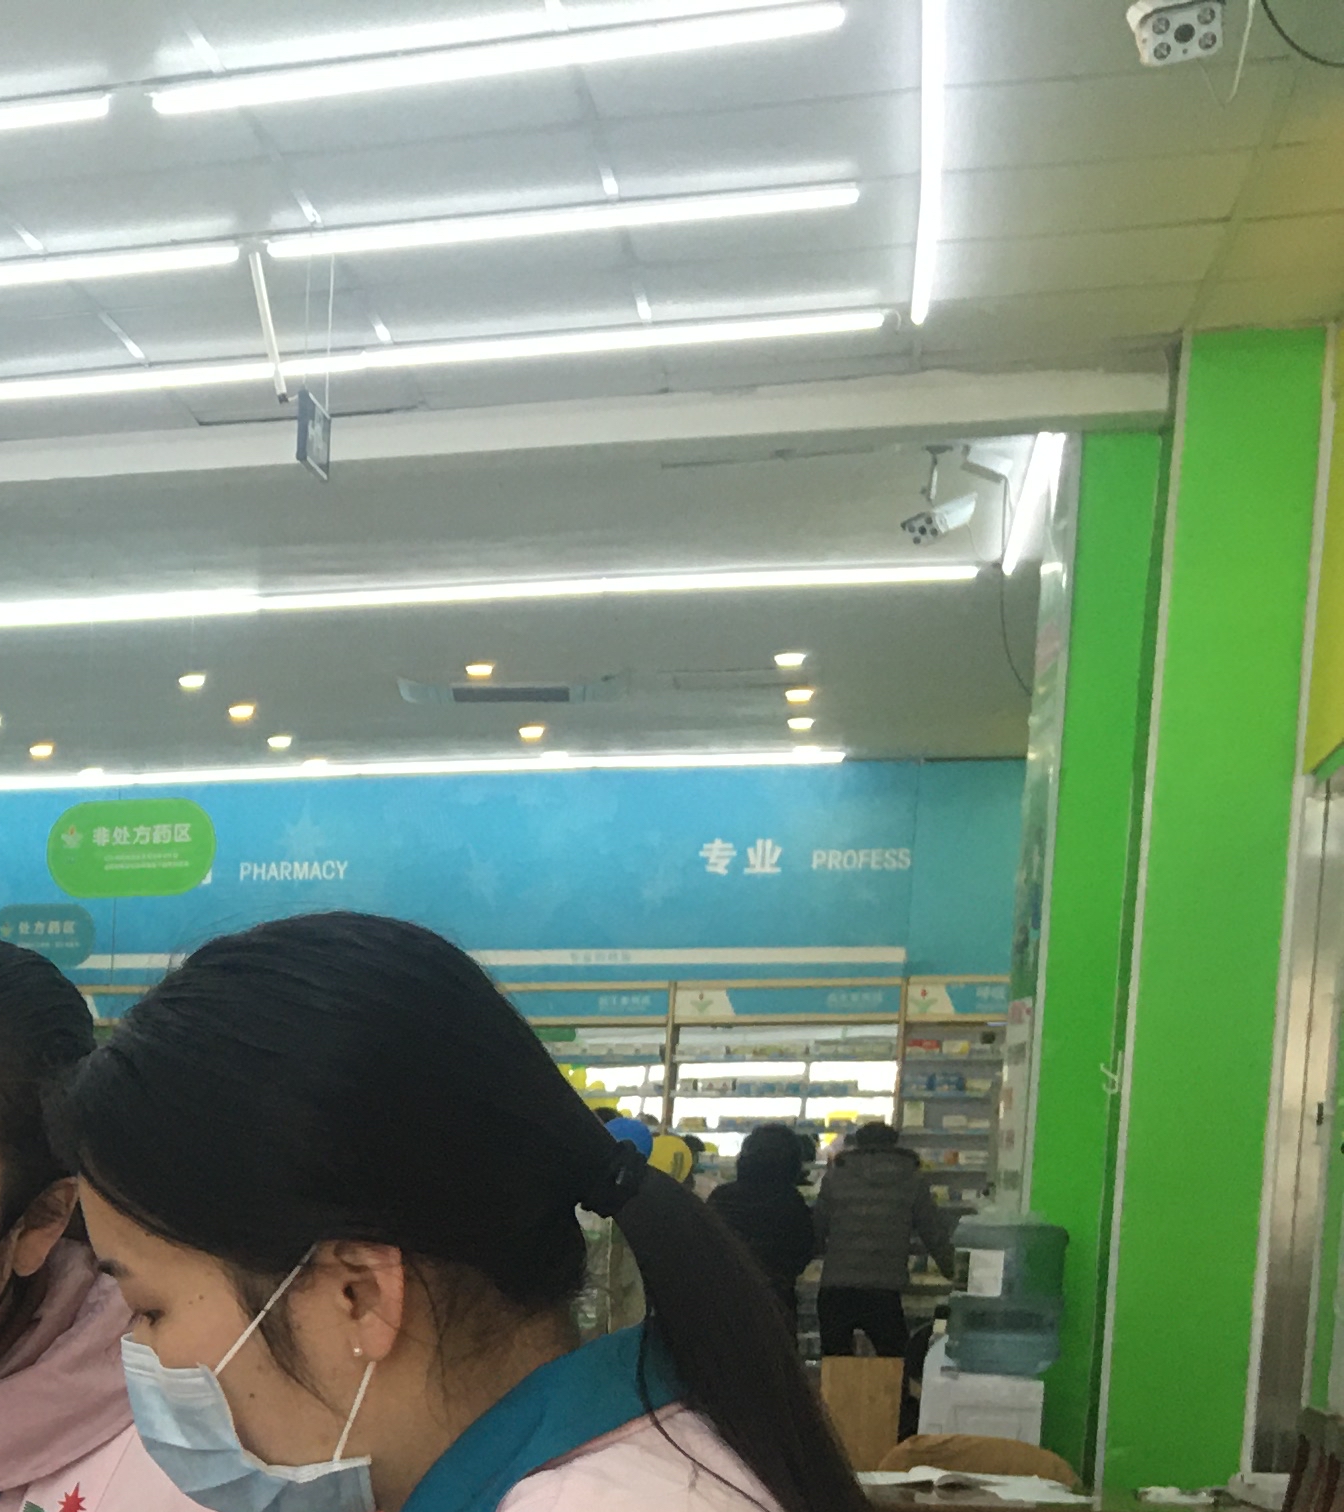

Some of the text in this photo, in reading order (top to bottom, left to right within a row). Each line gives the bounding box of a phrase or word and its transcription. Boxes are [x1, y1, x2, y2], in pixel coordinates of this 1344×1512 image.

[92, 823, 192, 846] 非处方药区
[699, 838, 783, 876] 专业
[810, 848, 912, 872] PROFESS
[238, 860, 349, 882] PHARMACY
